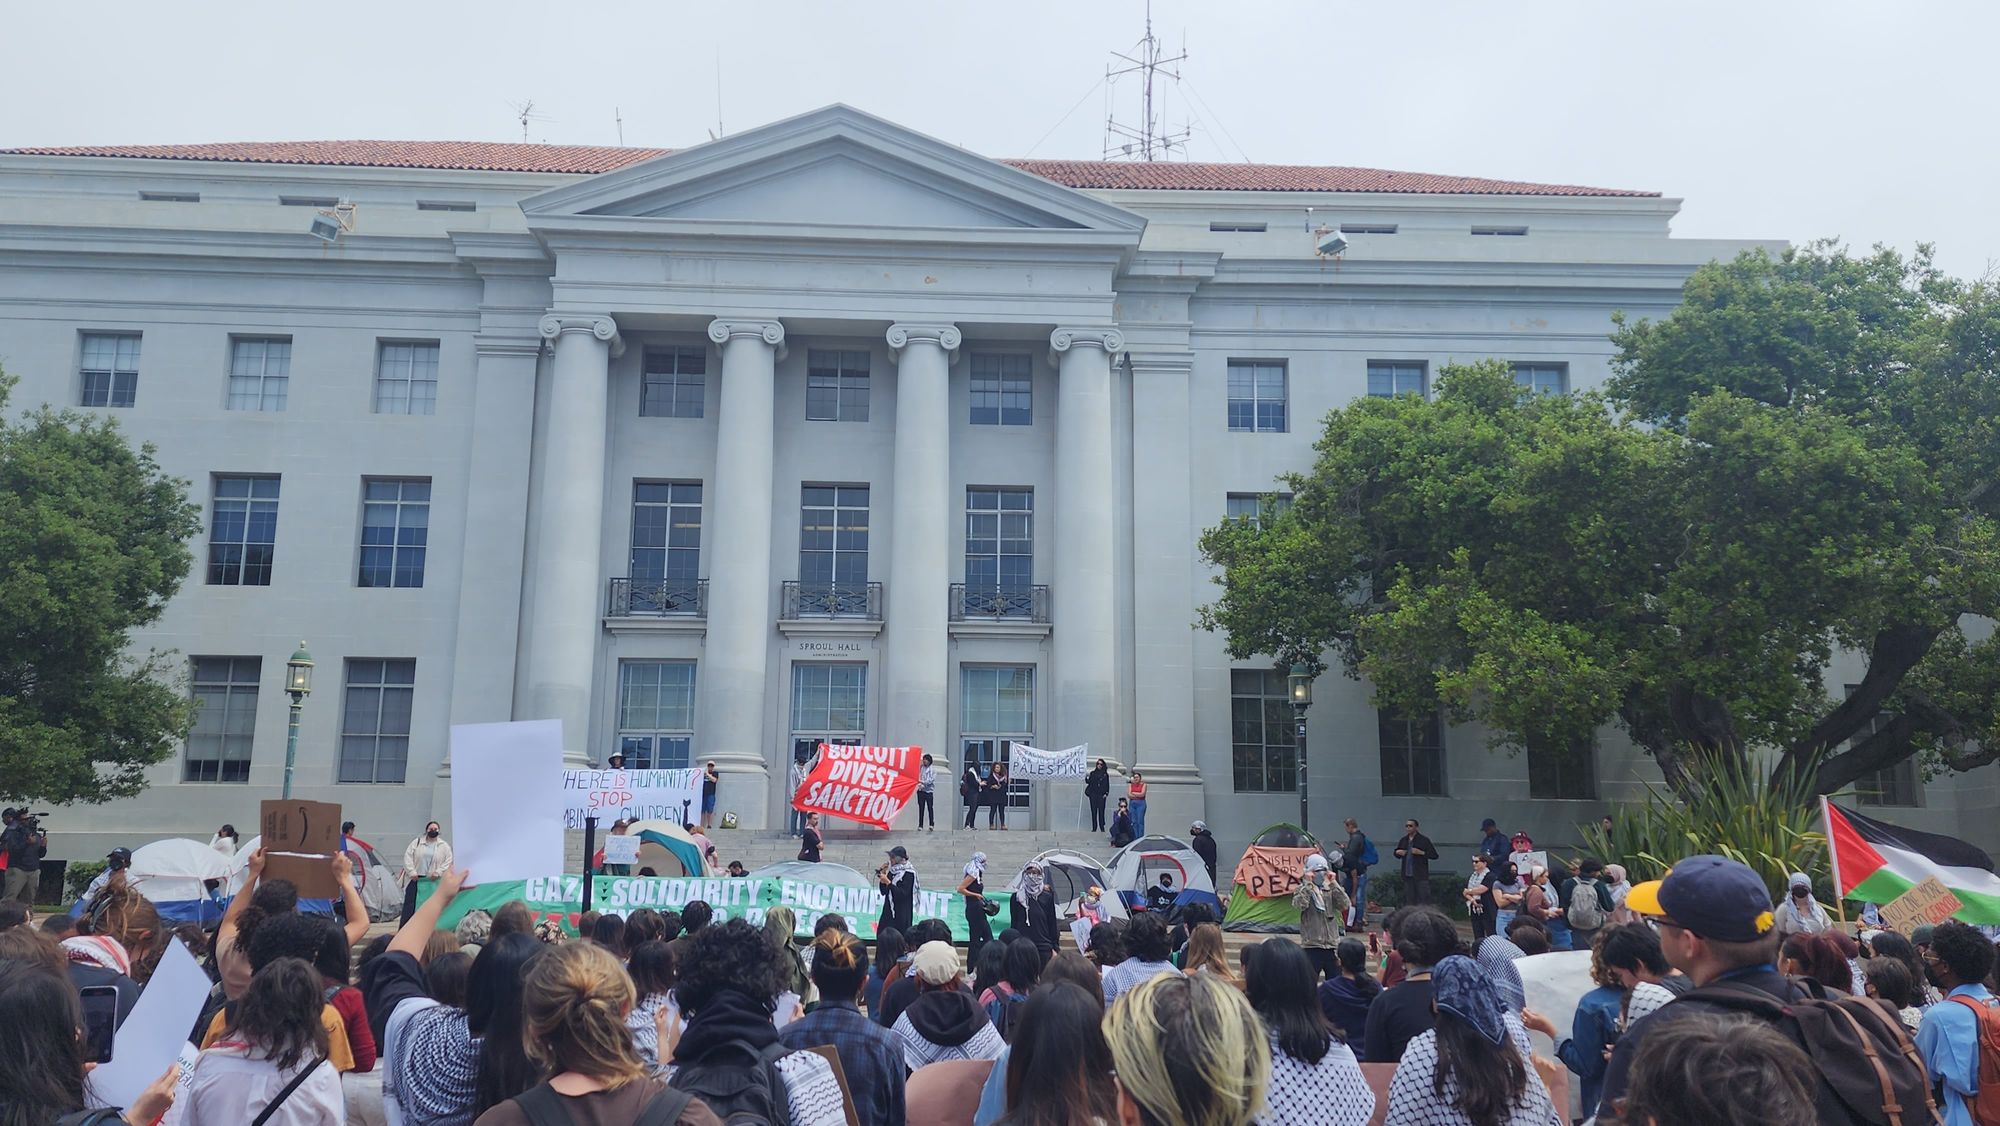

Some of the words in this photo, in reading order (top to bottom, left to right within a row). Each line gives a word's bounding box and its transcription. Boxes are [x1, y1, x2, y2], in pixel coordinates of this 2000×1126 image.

[799, 642, 833, 651] SPROUL
[838, 643, 861, 651] HALL
[827, 744, 909, 769] BOYCOTT
[1013, 761, 1085, 775] PALESTINE
[563, 770, 613, 790] HERE
[613, 773, 625, 789] IS
[629, 768, 701, 790] HUMANITY?
[828, 760, 898, 792] DIVEST
[588, 791, 633, 808] STOP
[803, 781, 900, 823] SANCTION
[620, 804, 681, 827] CHILDREN
[1248, 855, 1291, 867] JEWISH
[1274, 866, 1299, 875] FOR
[1252, 874, 1300, 897] PEA
[611, 879, 763, 907] SOLIDARITY
[781, 880, 953, 918] ENCAMPNT
[1883, 901, 1907, 925] NOT
[1903, 891, 1924, 912] ONE
